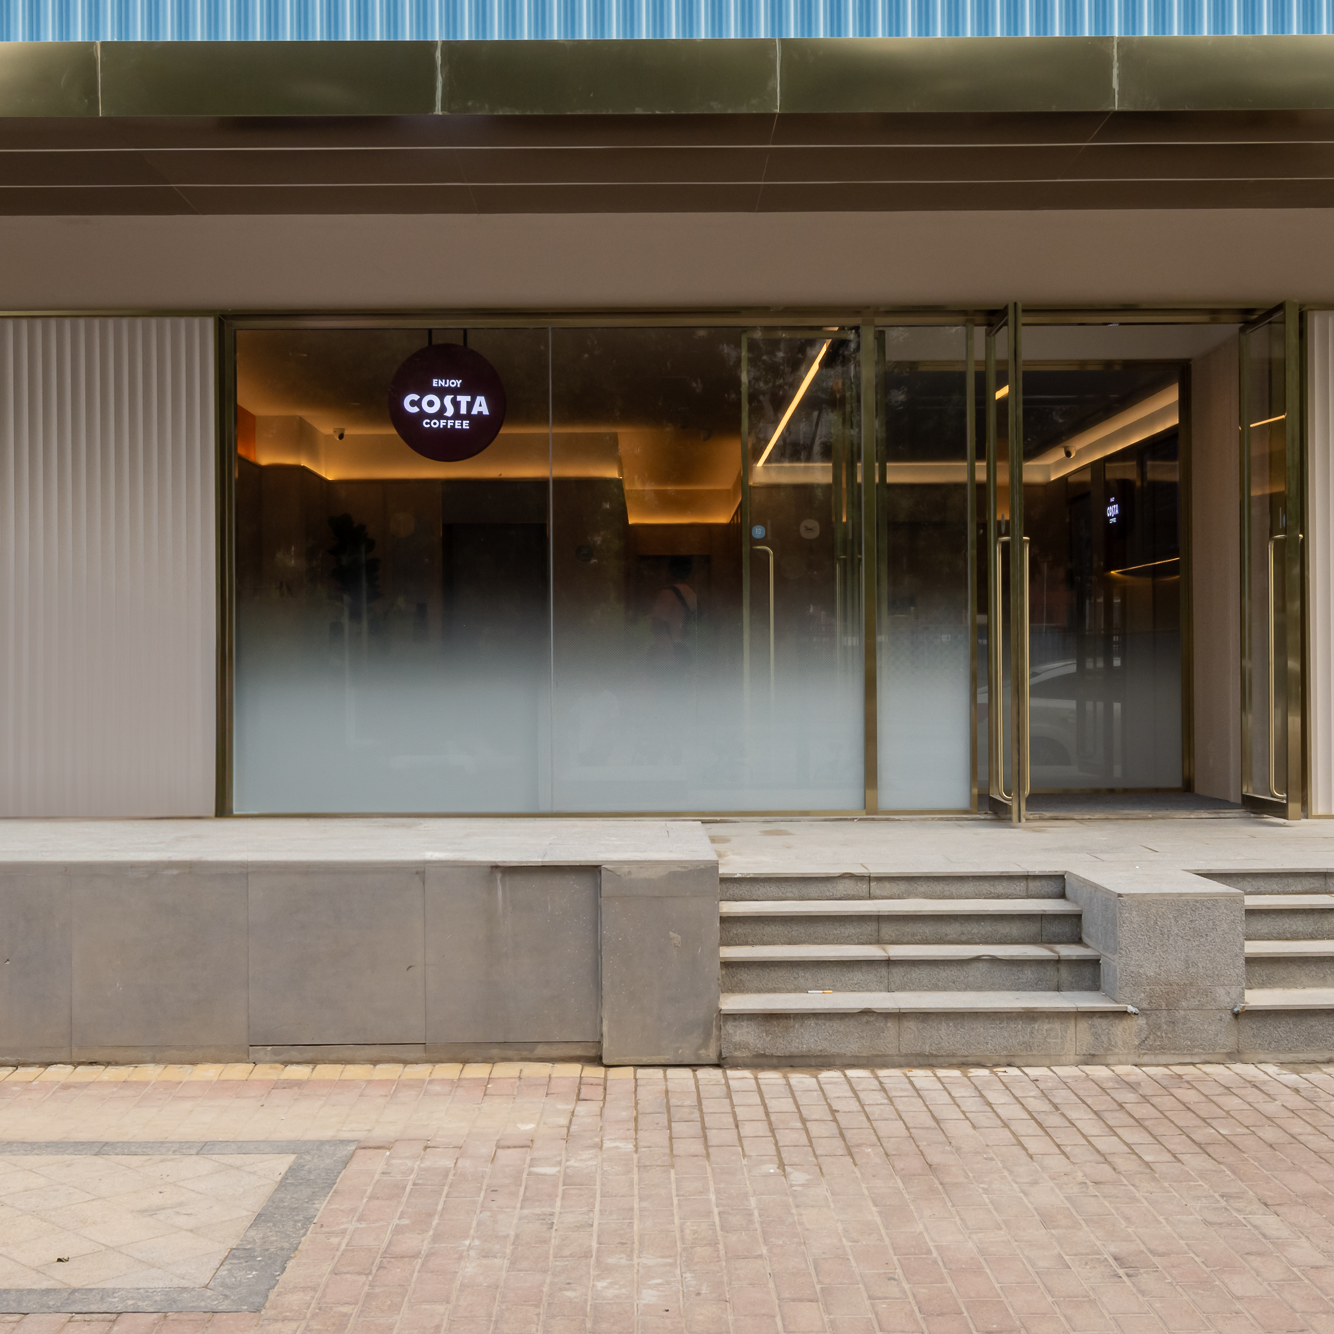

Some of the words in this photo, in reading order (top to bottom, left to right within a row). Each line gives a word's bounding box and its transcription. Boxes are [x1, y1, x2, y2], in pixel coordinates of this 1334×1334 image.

[432, 379, 462, 387] ENJOY
[403, 393, 490, 417] COSTA
[422, 419, 470, 429] COFFEE
